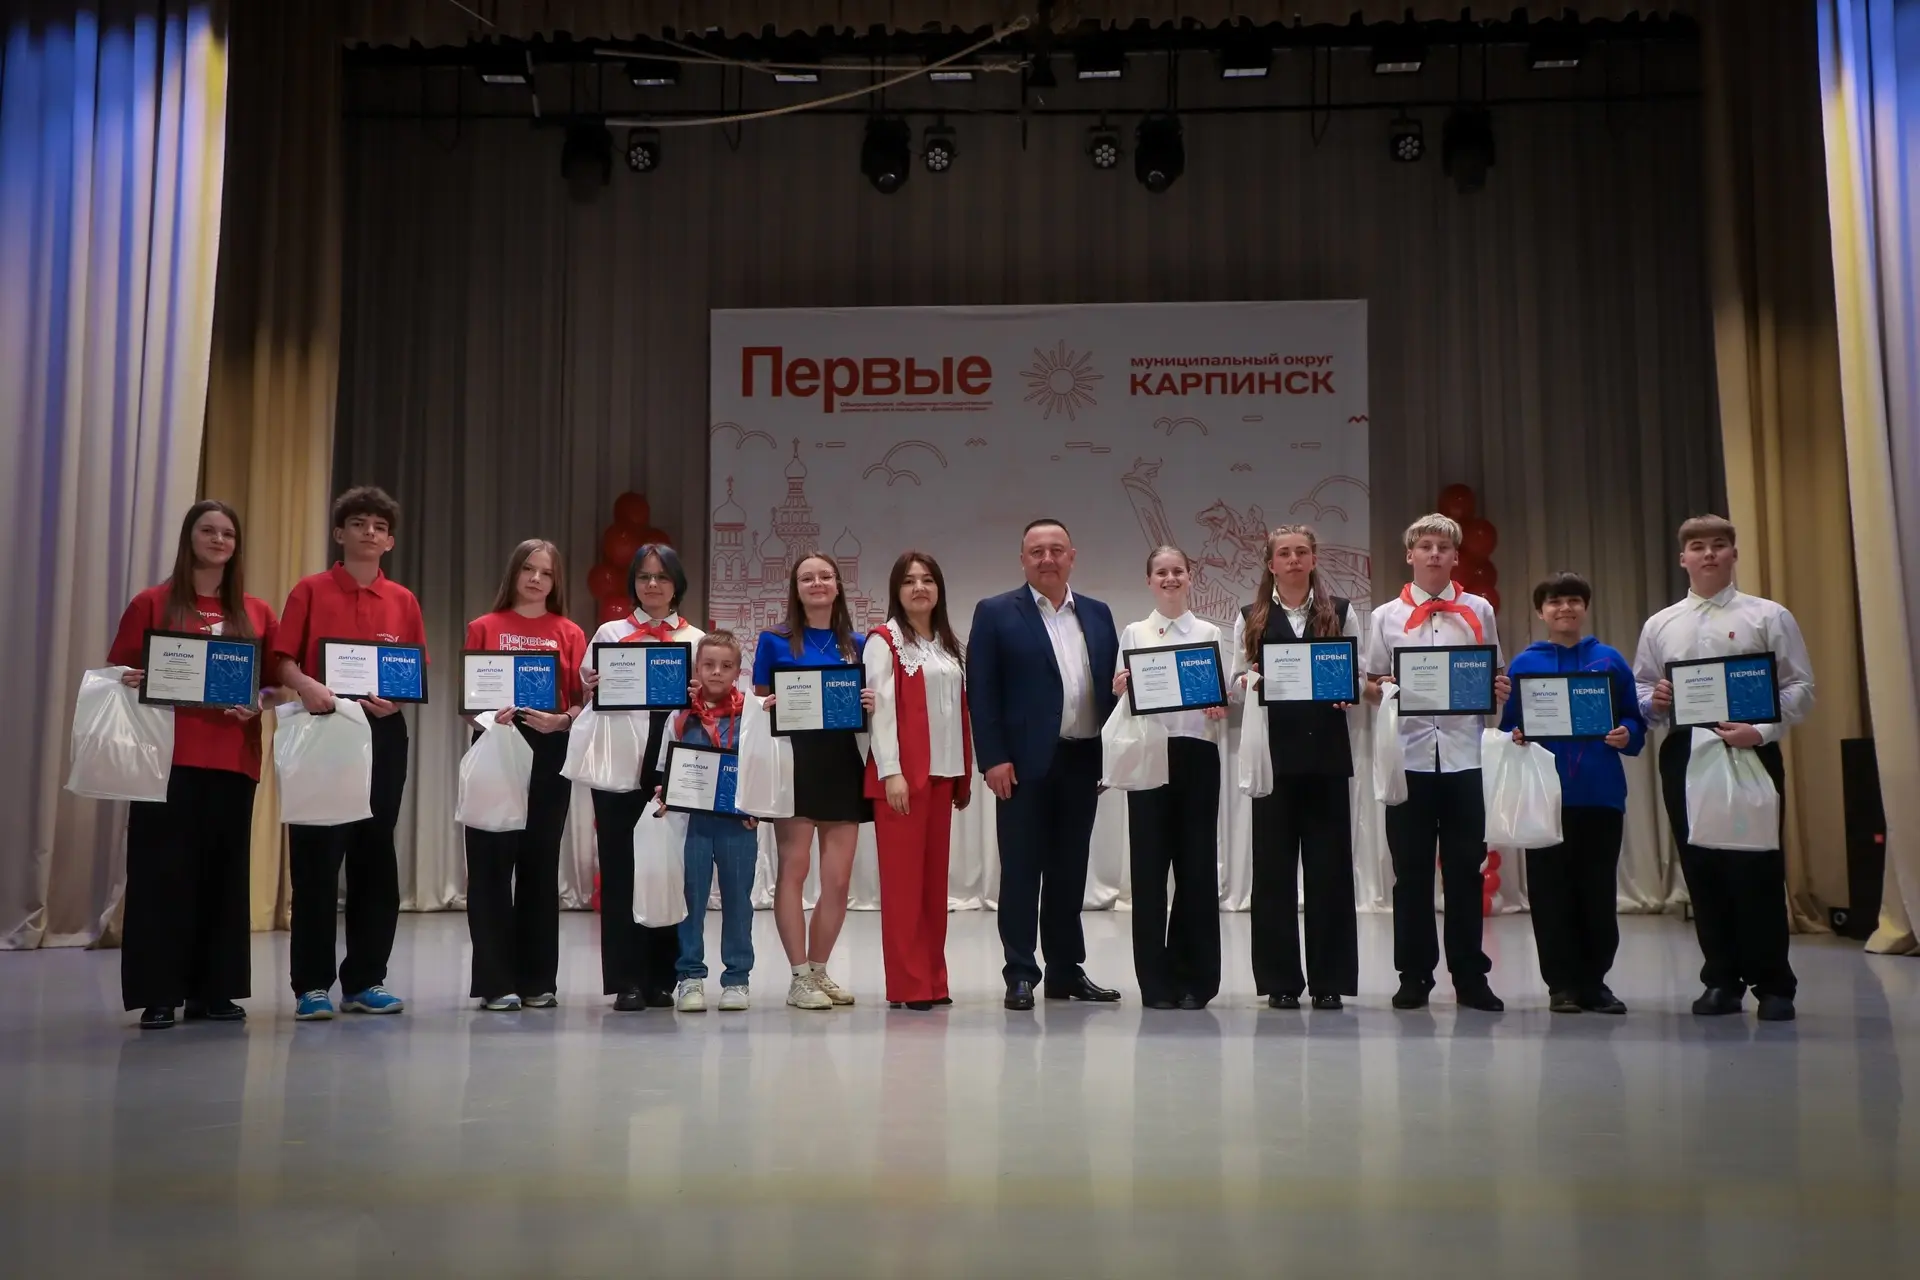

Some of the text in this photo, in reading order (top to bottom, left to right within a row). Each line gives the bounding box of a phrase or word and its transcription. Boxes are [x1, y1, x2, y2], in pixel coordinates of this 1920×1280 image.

[1130, 353, 1333, 369] муниципальный округ
[742, 346, 992, 413] Первые
[1130, 371, 1336, 395] КАРПИНСК
[211, 653, 249, 663] ПЕРВЫЕ
[382, 656, 416, 664] ПЕРВЫЕ
[1180, 659, 1211, 667] ПЕРВЫЕ
[1729, 669, 1766, 678] ПЕРВЫЕ
[723, 765, 739, 773] ПЕР
